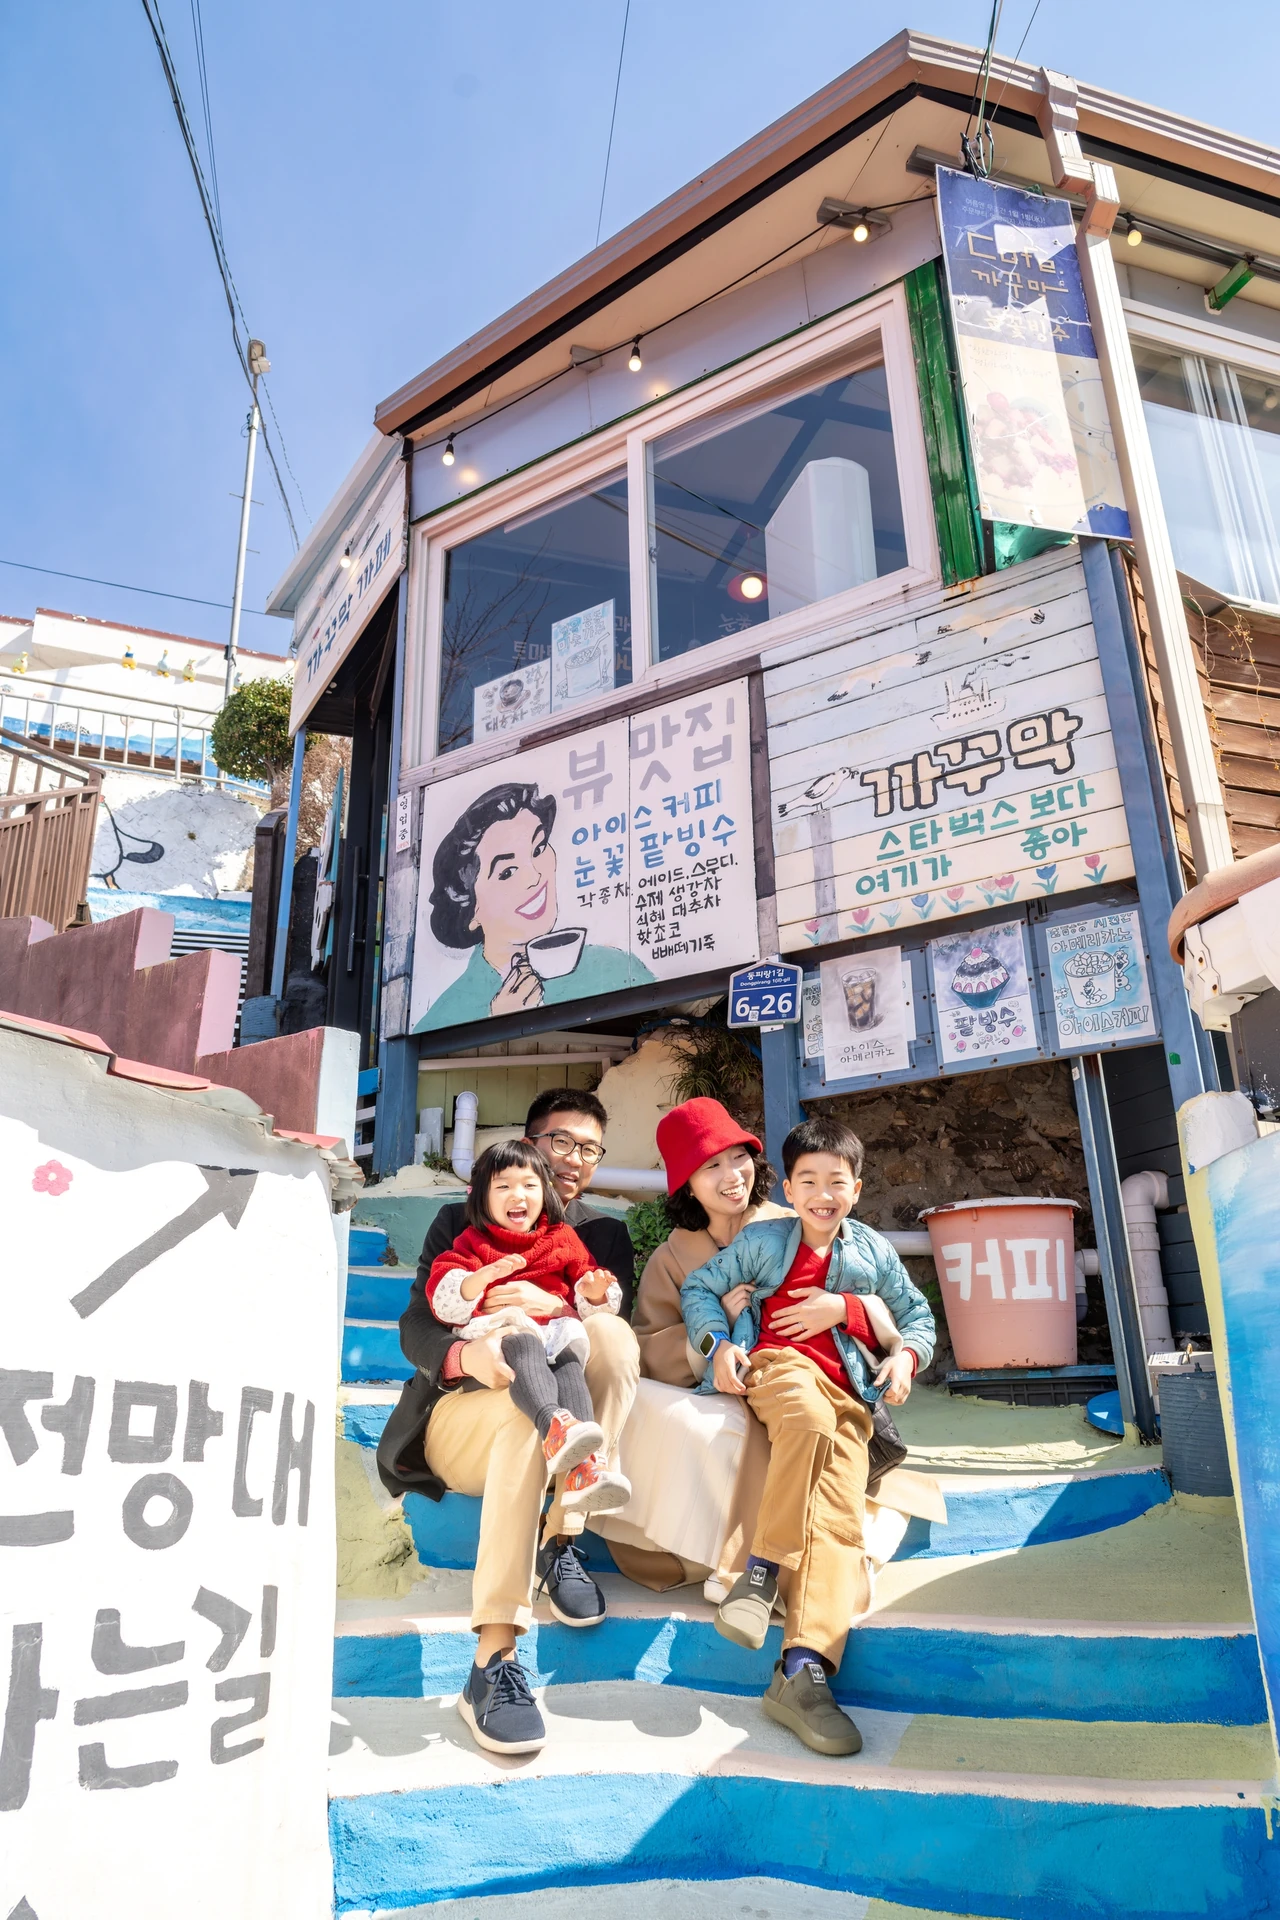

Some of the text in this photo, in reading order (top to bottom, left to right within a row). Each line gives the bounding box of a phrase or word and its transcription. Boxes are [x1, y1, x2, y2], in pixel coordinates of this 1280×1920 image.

[971, 270, 1069, 300] 까꾸막
[307, 528, 392, 683] 까꾸막 까페
[562, 697, 735, 811] 뷰 맛집
[860, 707, 1083, 817] 까꾸막
[399, 798, 408, 840] 영업중
[640, 814, 737, 869] 팥빙수
[855, 822, 1088, 895] 여기가 좋아
[635, 876, 722, 912] 수제 생강차
[672, 894, 721, 917] 대추차
[652, 934, 715, 960] 빼떼기죽
[1051, 927, 1138, 954] 아메리카노
[747, 968, 785, 980] 동피랑1길
[735, 992, 793, 1017] 6-26
[954, 1006, 1017, 1037] 팥빙수
[840, 1048, 895, 1063] 아메리카노
[844, 1040, 885, 1054] 아이스
[941, 1238, 1067, 1302] 커피
[0, 1367, 315, 1551] 전망대
